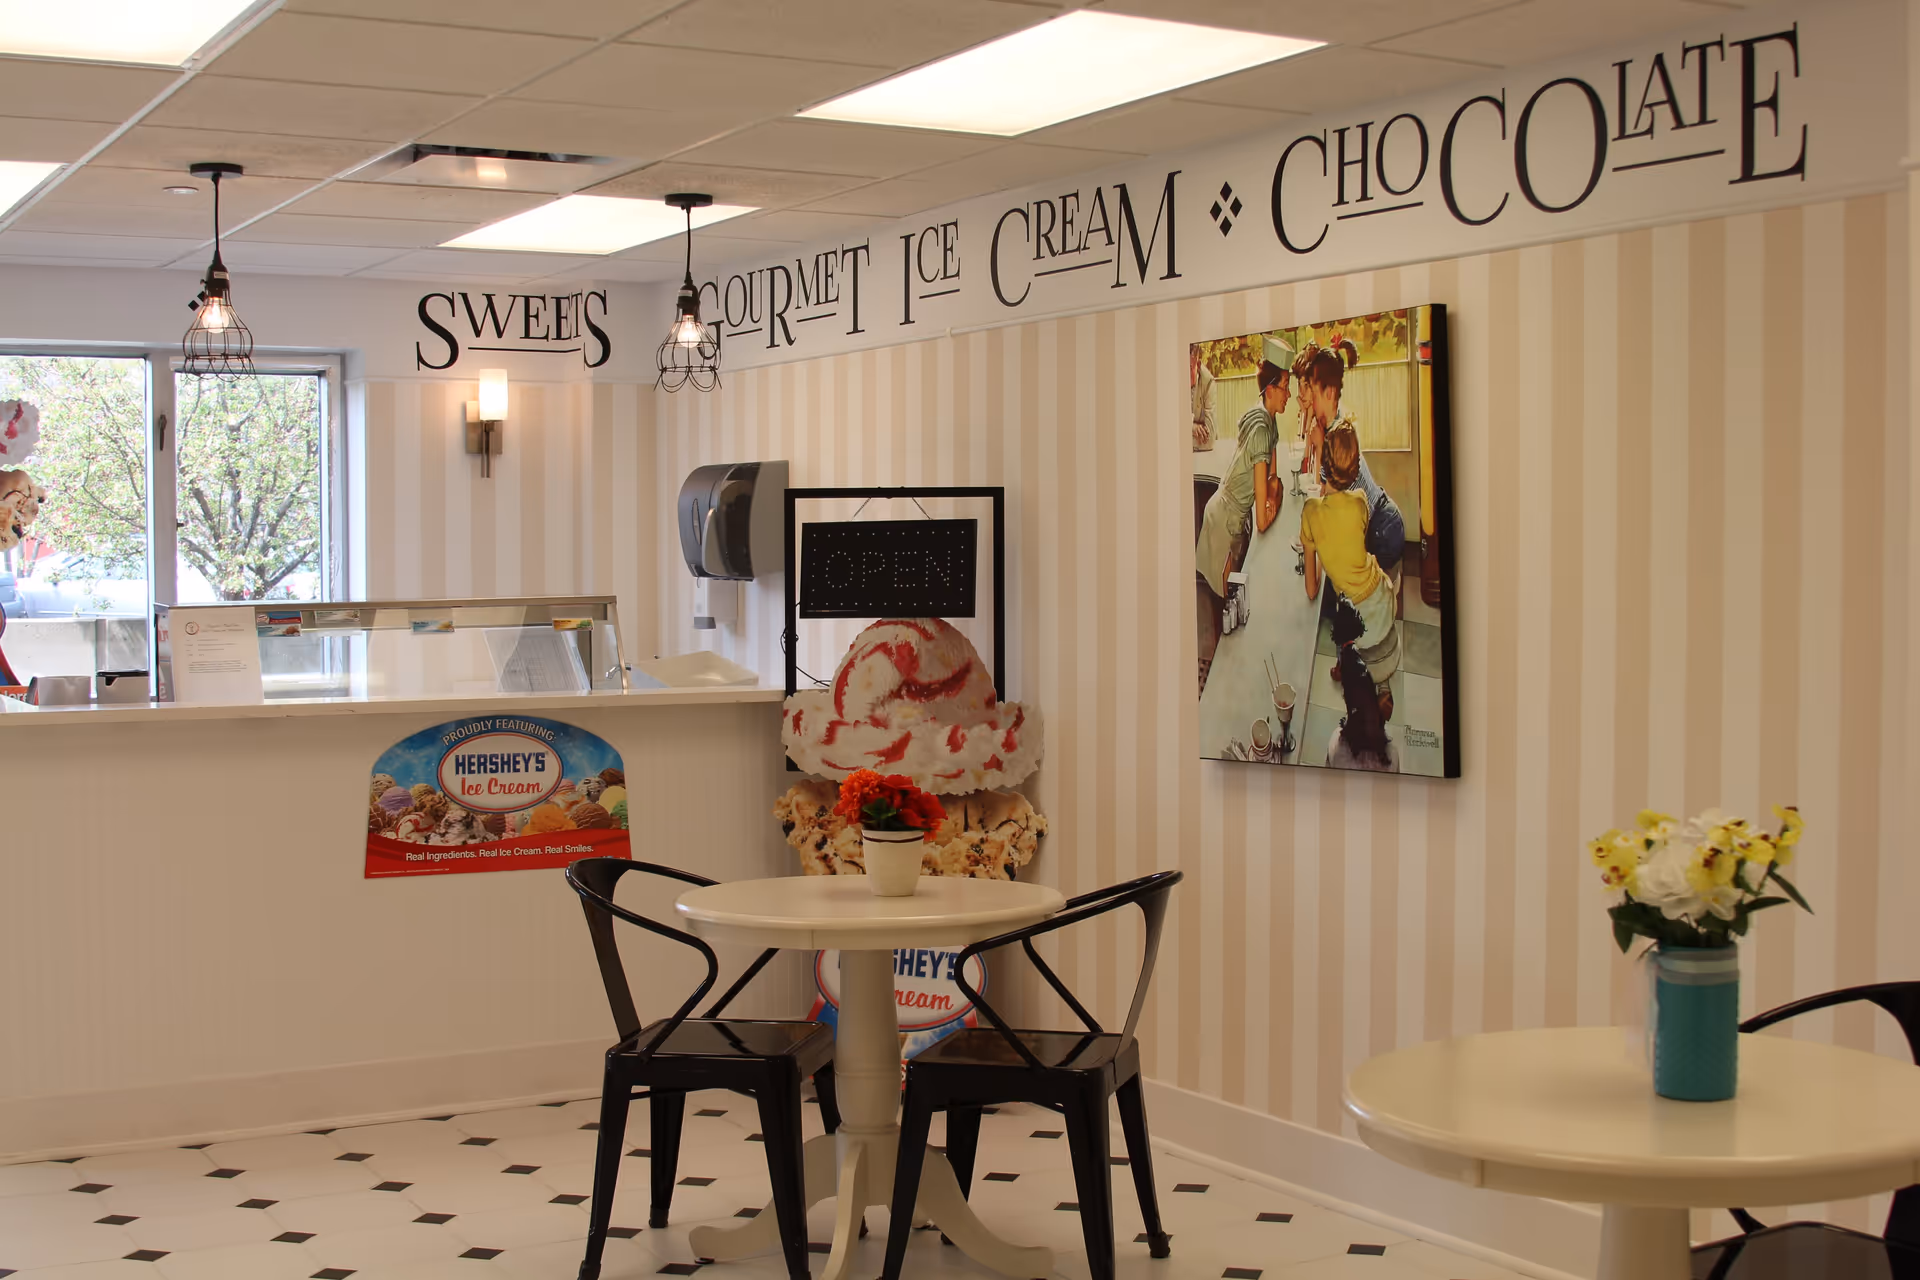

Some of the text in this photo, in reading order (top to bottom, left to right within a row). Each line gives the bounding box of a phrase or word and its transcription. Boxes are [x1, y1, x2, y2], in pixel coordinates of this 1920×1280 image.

[899, 218, 961, 326] ICE
[989, 170, 1183, 308] CREAM
[1270, 21, 1808, 256] CHOCOLATE
[416, 288, 612, 371] SWEETS
[825, 550, 951, 588] OPEN
[442, 718, 557, 746] PROUDLY FEATURING:
[455, 752, 546, 775] HERSHEY'S
[461, 777, 543, 796] Ice Cream
[406, 844, 594, 862] Real Ingredients. Real Ice Cream. Real Smiles.
[894, 989, 954, 1011] ream
